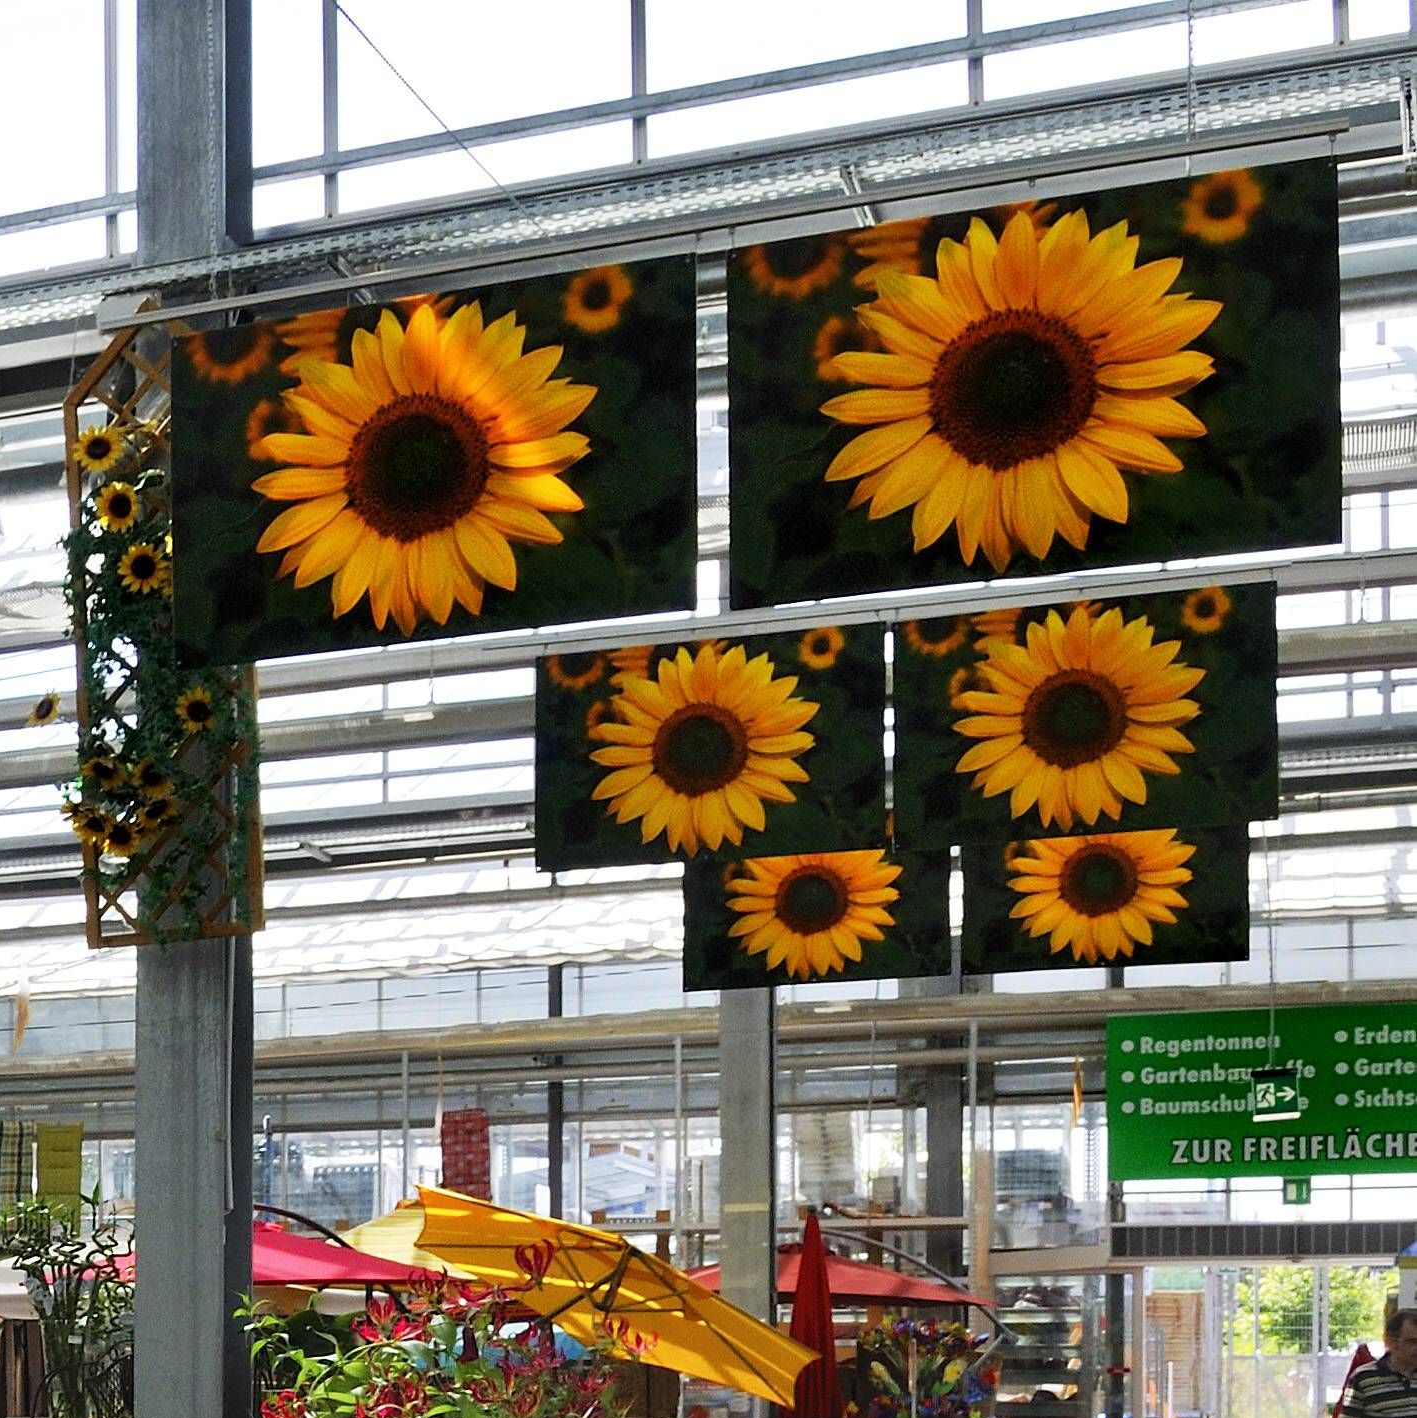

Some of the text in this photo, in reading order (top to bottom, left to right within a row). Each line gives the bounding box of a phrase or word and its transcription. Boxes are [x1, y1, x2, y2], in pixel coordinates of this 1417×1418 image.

[1139, 1033, 1280, 1057] Regentonnen
[1354, 1024, 1417, 1046] Erden
[1354, 1057, 1417, 1077] Garte
[1171, 1127, 1417, 1164] ZUR FREIFLÄCHE
